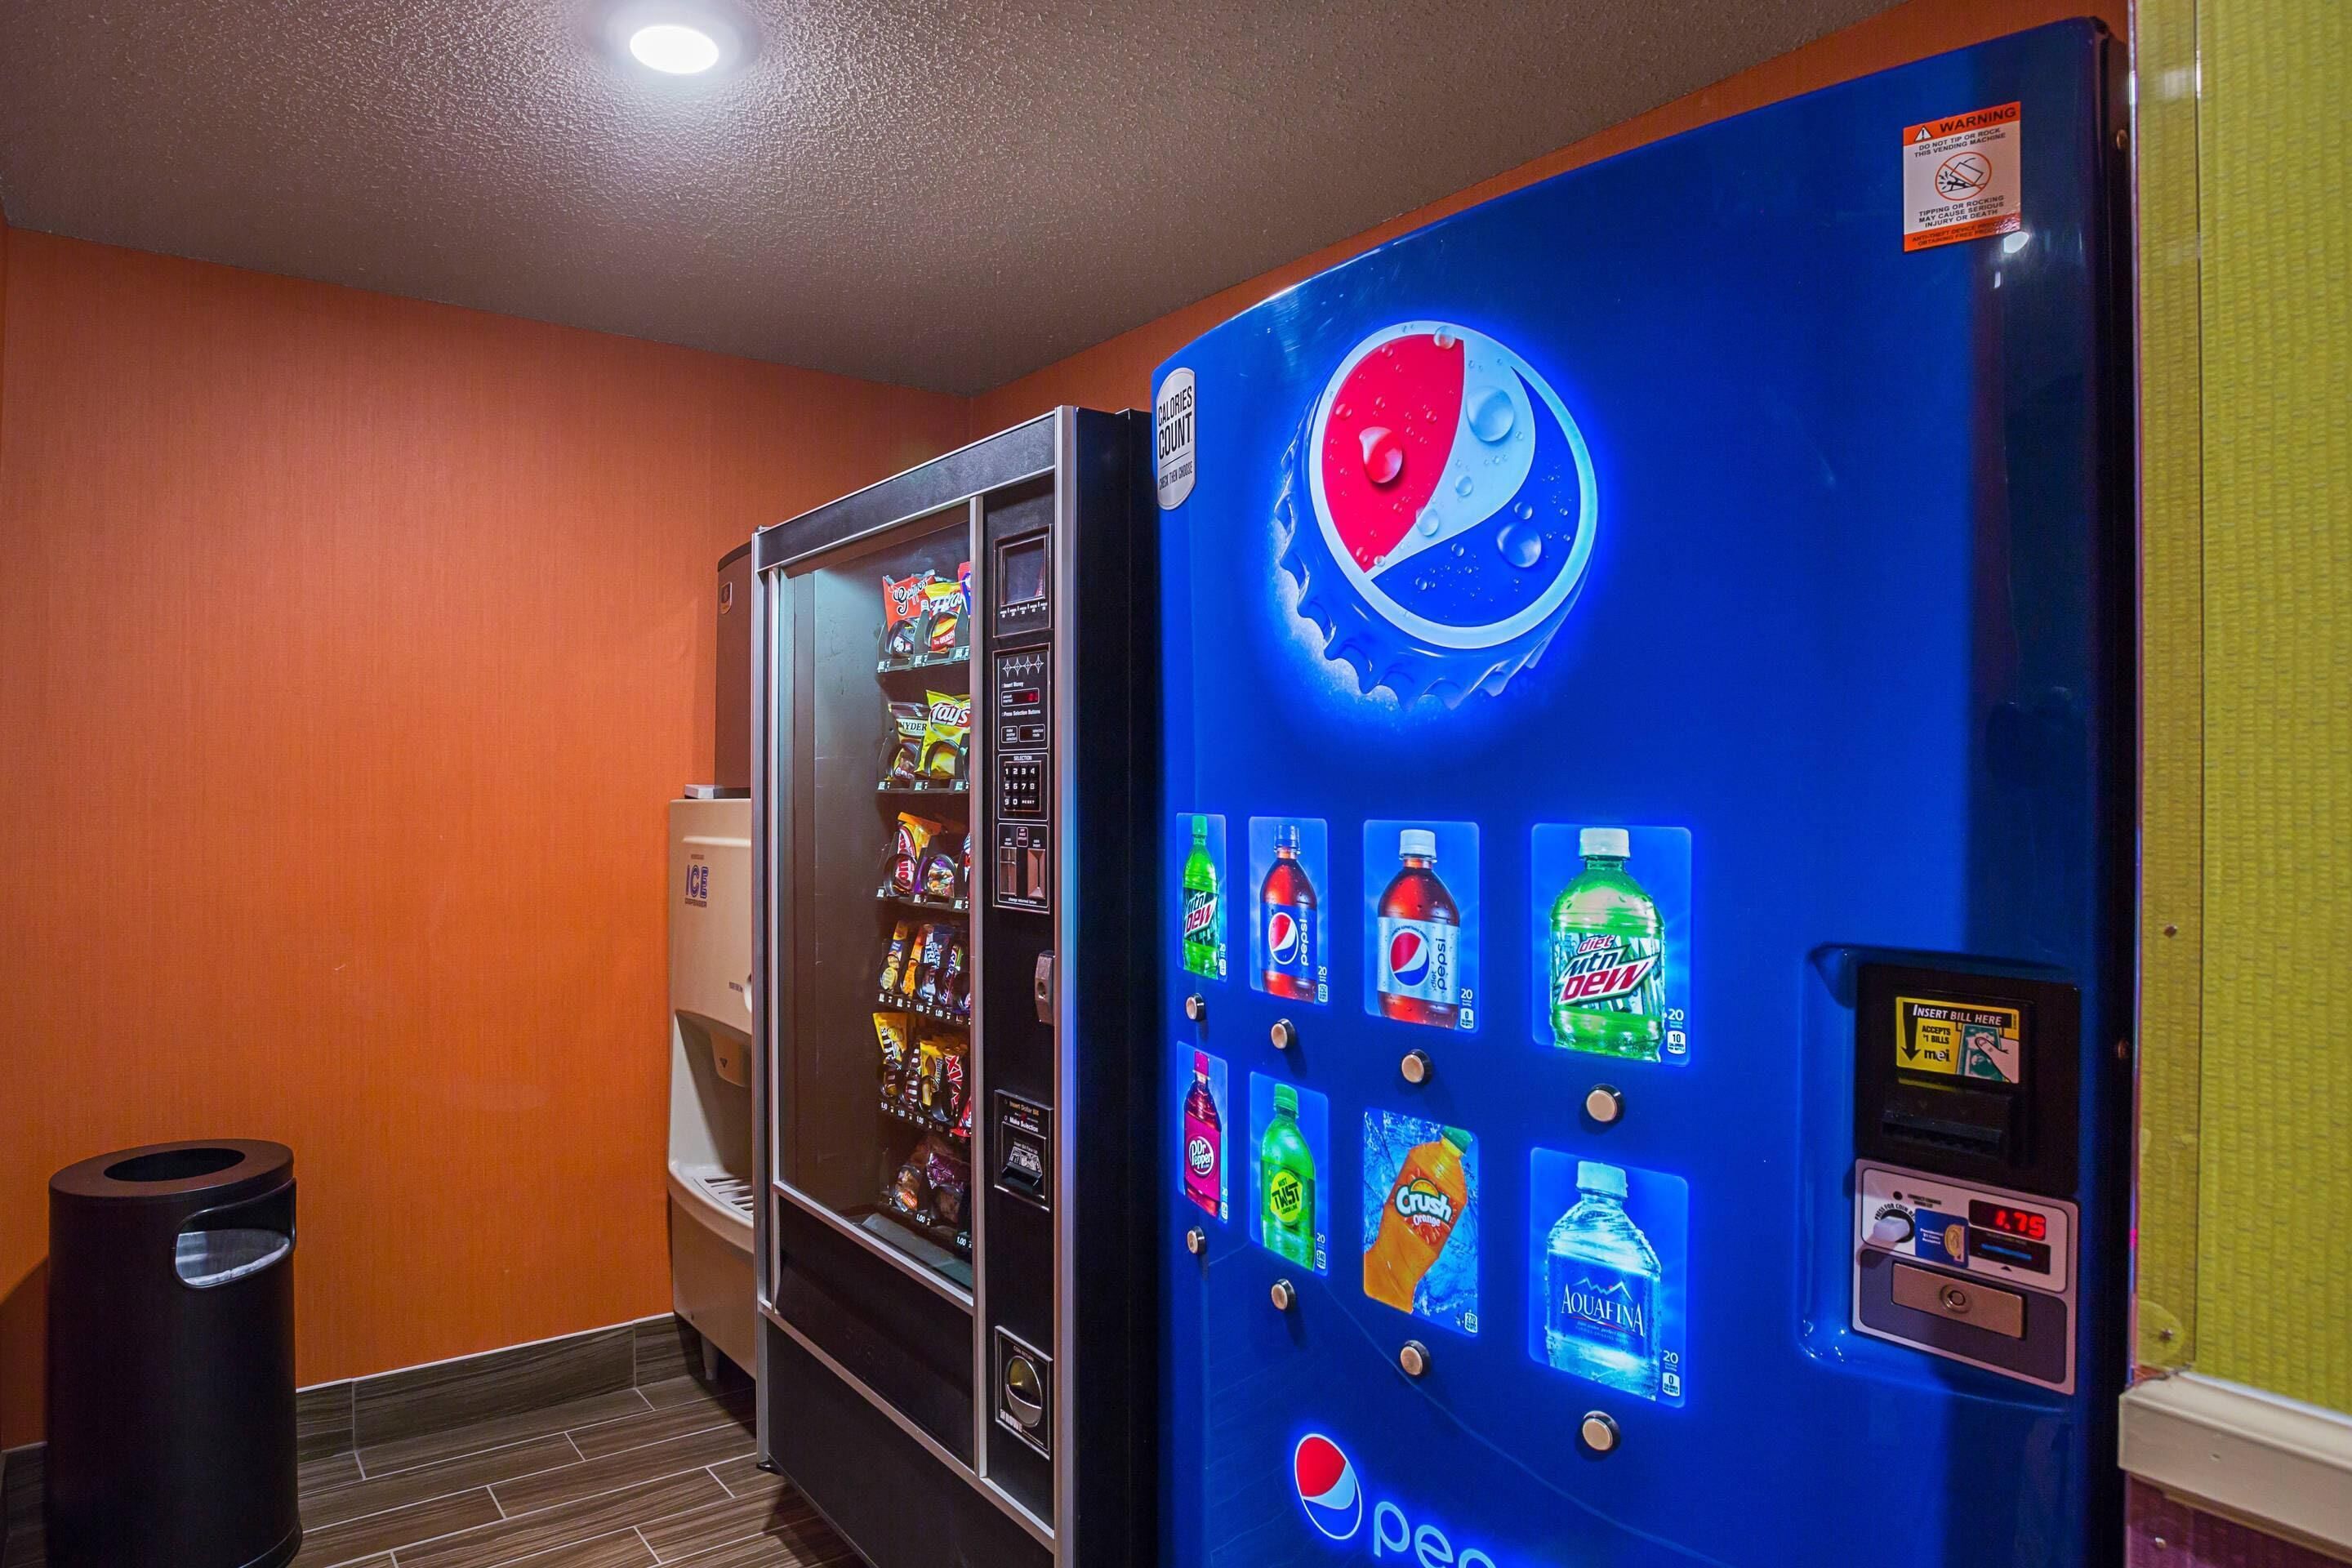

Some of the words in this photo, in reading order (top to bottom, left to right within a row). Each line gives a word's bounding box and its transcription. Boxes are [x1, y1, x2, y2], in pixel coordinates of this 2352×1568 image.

[1940, 107, 2016, 133] WARNING
[1914, 149, 1931, 158] THIS
[1934, 141, 1967, 154] VENDING
[1970, 132, 2006, 145] MACHINE
[1919, 143, 1930, 151] DO
[1932, 139, 1948, 148] NOT
[1950, 136, 1961, 145] TIP
[1964, 132, 1976, 141] OR
[1978, 127, 2001, 139] ROCK
[1919, 205, 1949, 217] TIPPING
[1953, 202, 1964, 211] OR
[1967, 195, 2005, 207] ROCKING
[1919, 214, 1936, 223] MAY
[1938, 208, 1966, 220] CAUSE
[1967, 202, 2004, 213] SERIOUS
[1925, 217, 1953, 229] INJURY
[1956, 214, 1968, 222] OR
[1971, 209, 1998, 220] DEATH
[1158, 385, 1192, 426] CALORIES
[1159, 412, 1192, 460] COUNT
[686, 865, 709, 899] ICE
[1300, 918, 1310, 966] pepsi
[1579, 935, 1613, 954] diet
[1436, 938, 1448, 991] pepsi
[1461, 988, 1472, 1000] 20
[1668, 1009, 1684, 1021] 20
[1913, 1004, 1948, 1019] INSERT
[1949, 1011, 1971, 1022] BILL
[1975, 1014, 2002, 1026] HERE
[1673, 1034, 1681, 1043] 10
[1922, 1025, 1951, 1036] ACCEPTS
[1931, 1036, 1949, 1044] BILLS
[1924, 1049, 1950, 1062] mei
[1190, 1140, 1211, 1169] Pepper
[1197, 1140, 1206, 1154] Dr
[1396, 1186, 1452, 1222] Crush
[1875, 1206, 1885, 1220] PRESS
[1895, 1203, 1909, 1212] COIN
[1413, 1214, 1441, 1227] Orange
[1996, 1209, 2046, 1241] 1.75
[1316, 1232, 1325, 1244] 20
[1561, 1283, 1646, 1338] AQUAFINA
[1663, 1350, 1678, 1364] 20
